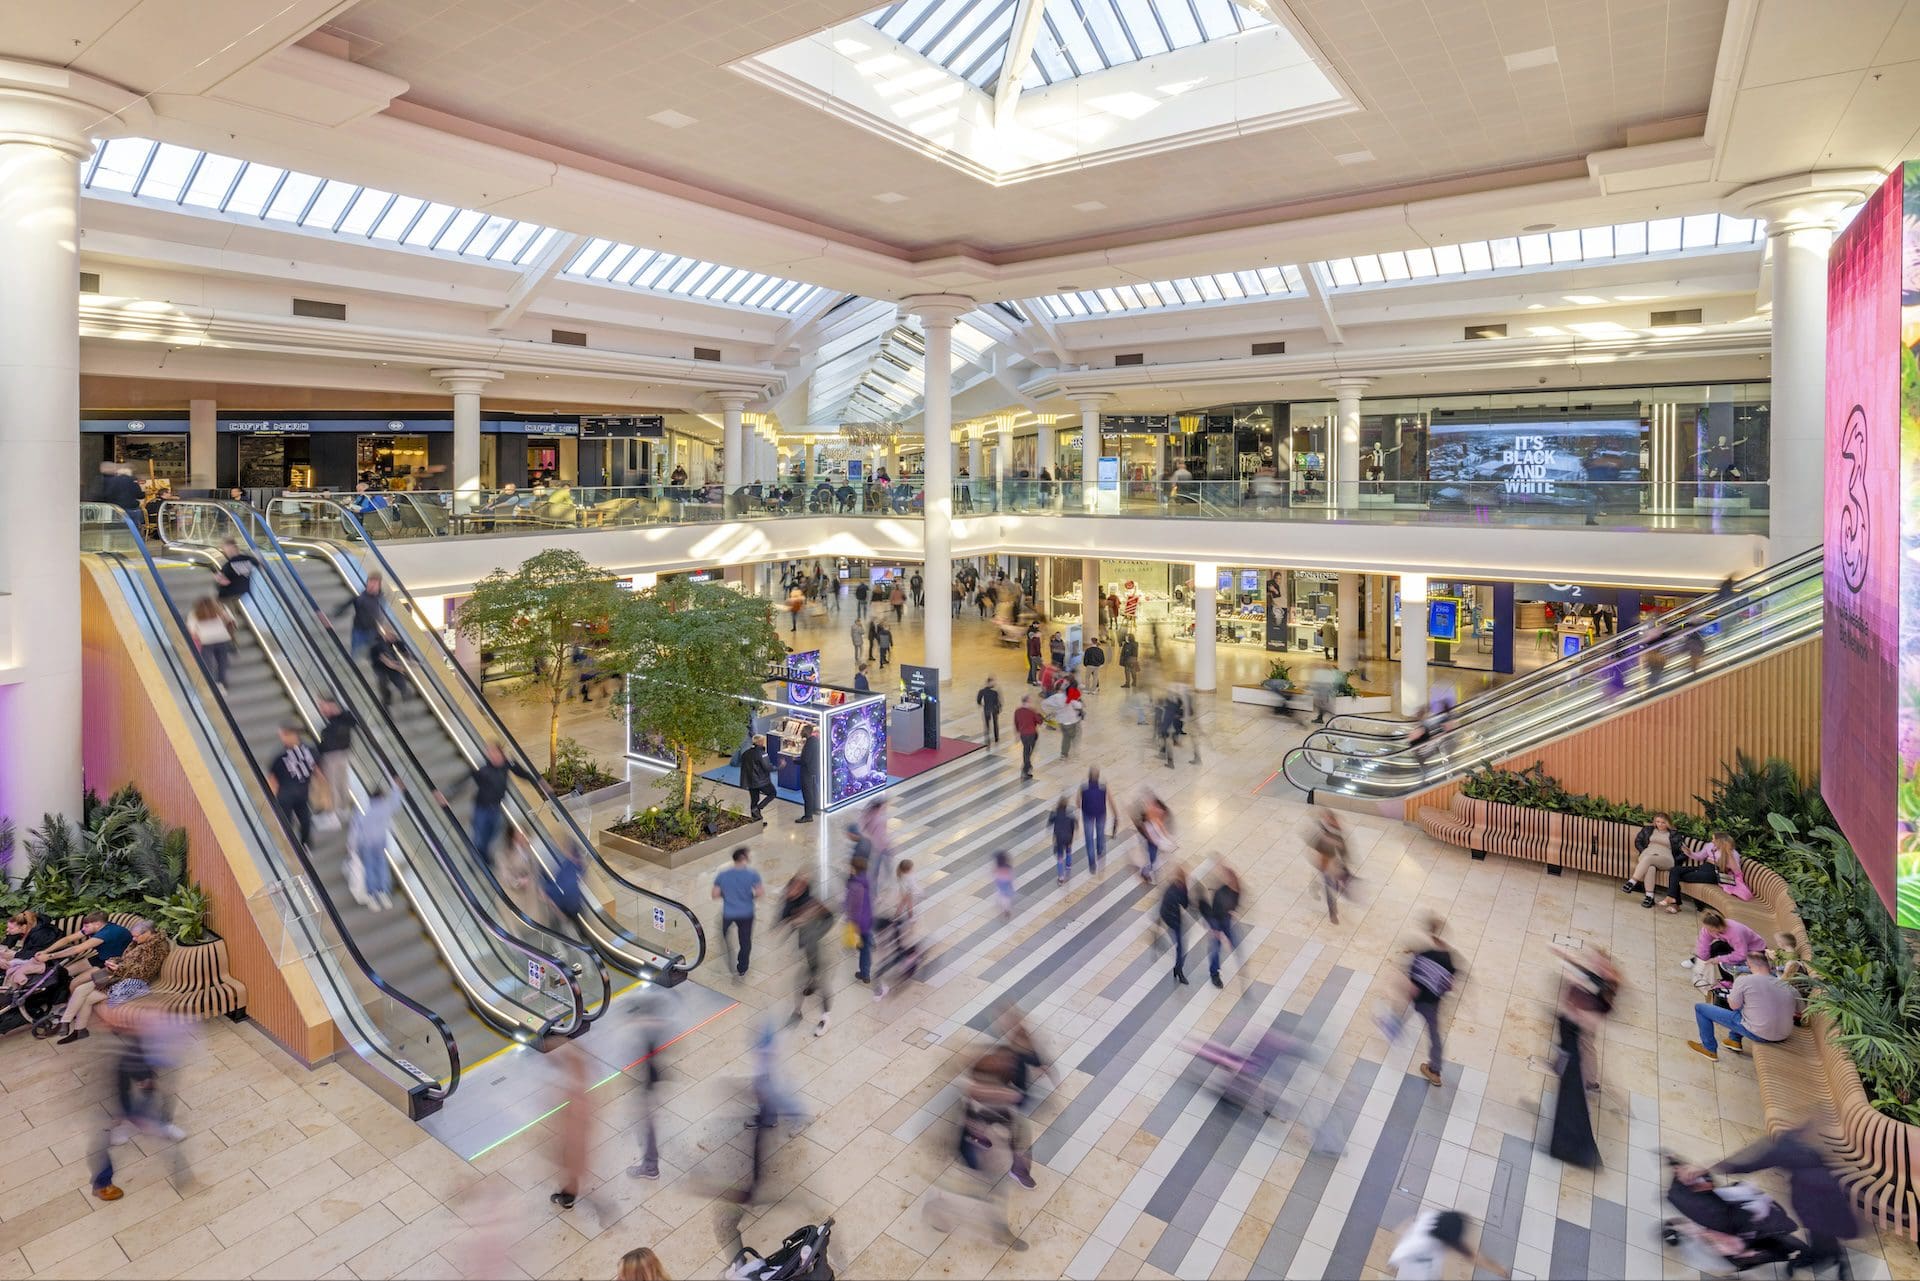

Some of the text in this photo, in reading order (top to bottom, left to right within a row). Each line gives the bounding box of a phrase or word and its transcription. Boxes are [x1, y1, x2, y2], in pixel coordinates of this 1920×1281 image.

[273, 423, 309, 431] NERO
[1515, 436, 1544, 451] IT'S
[1503, 450, 1556, 465] BLACK
[1513, 464, 1547, 479] AND
[1504, 479, 1555, 494] WHITE
[689, 574, 709, 582] TUDOR
